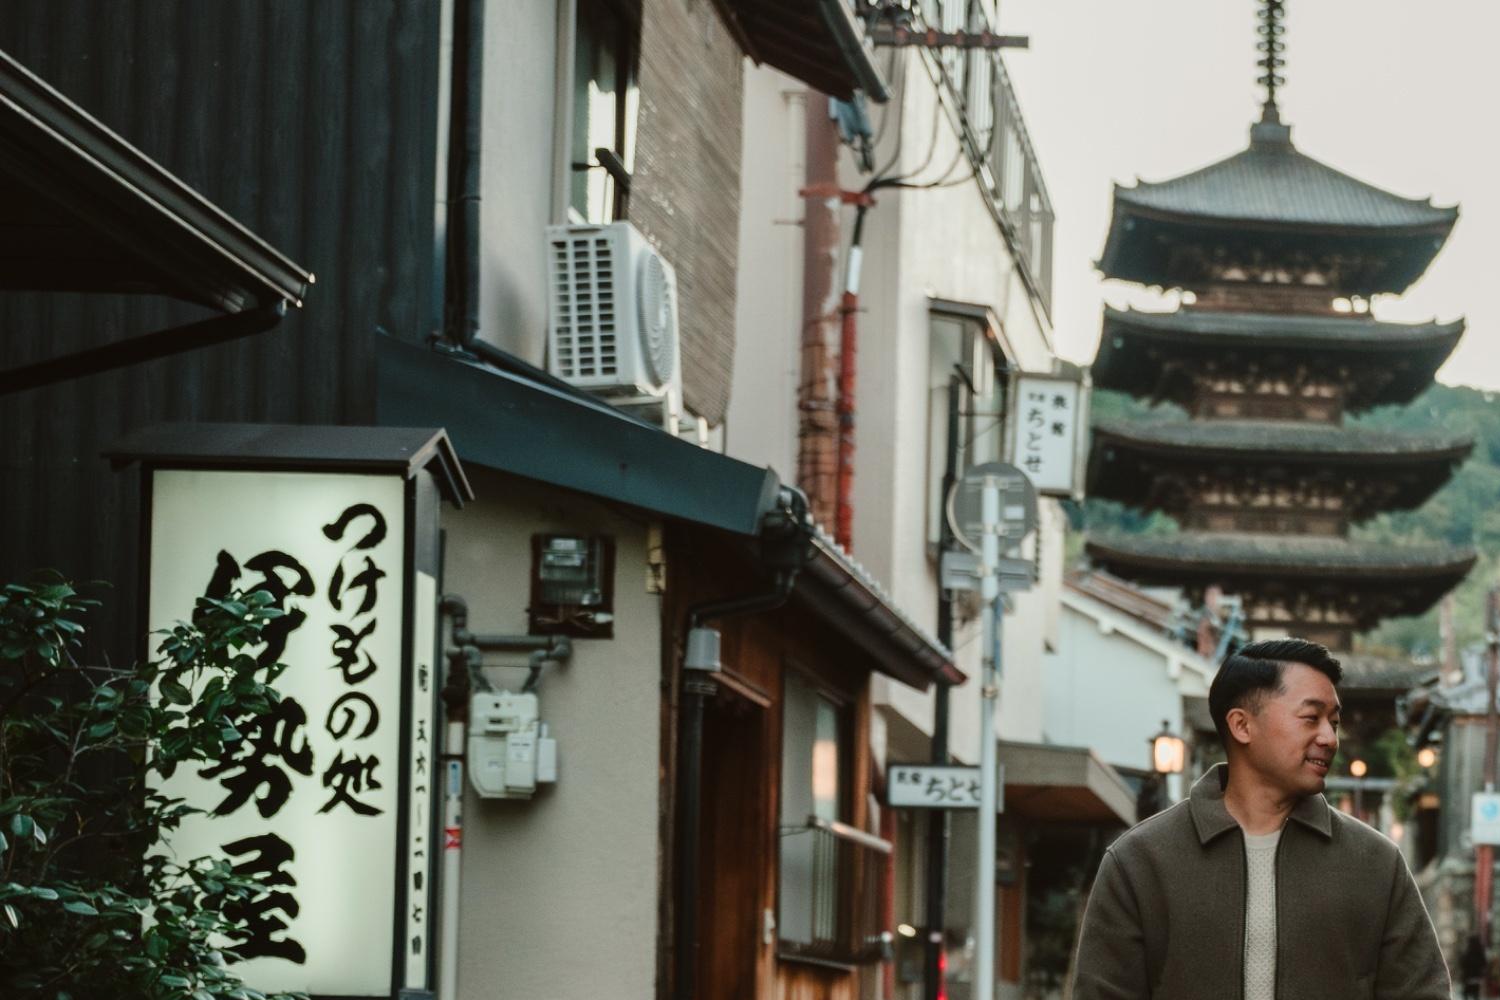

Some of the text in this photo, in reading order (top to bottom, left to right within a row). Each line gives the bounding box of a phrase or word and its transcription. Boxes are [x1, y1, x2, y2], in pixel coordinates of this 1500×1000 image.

[1024, 408, 1045, 473] ちとせ
[191, 549, 316, 966] 伊勢屋
[315, 502, 388, 817] つけもの処
